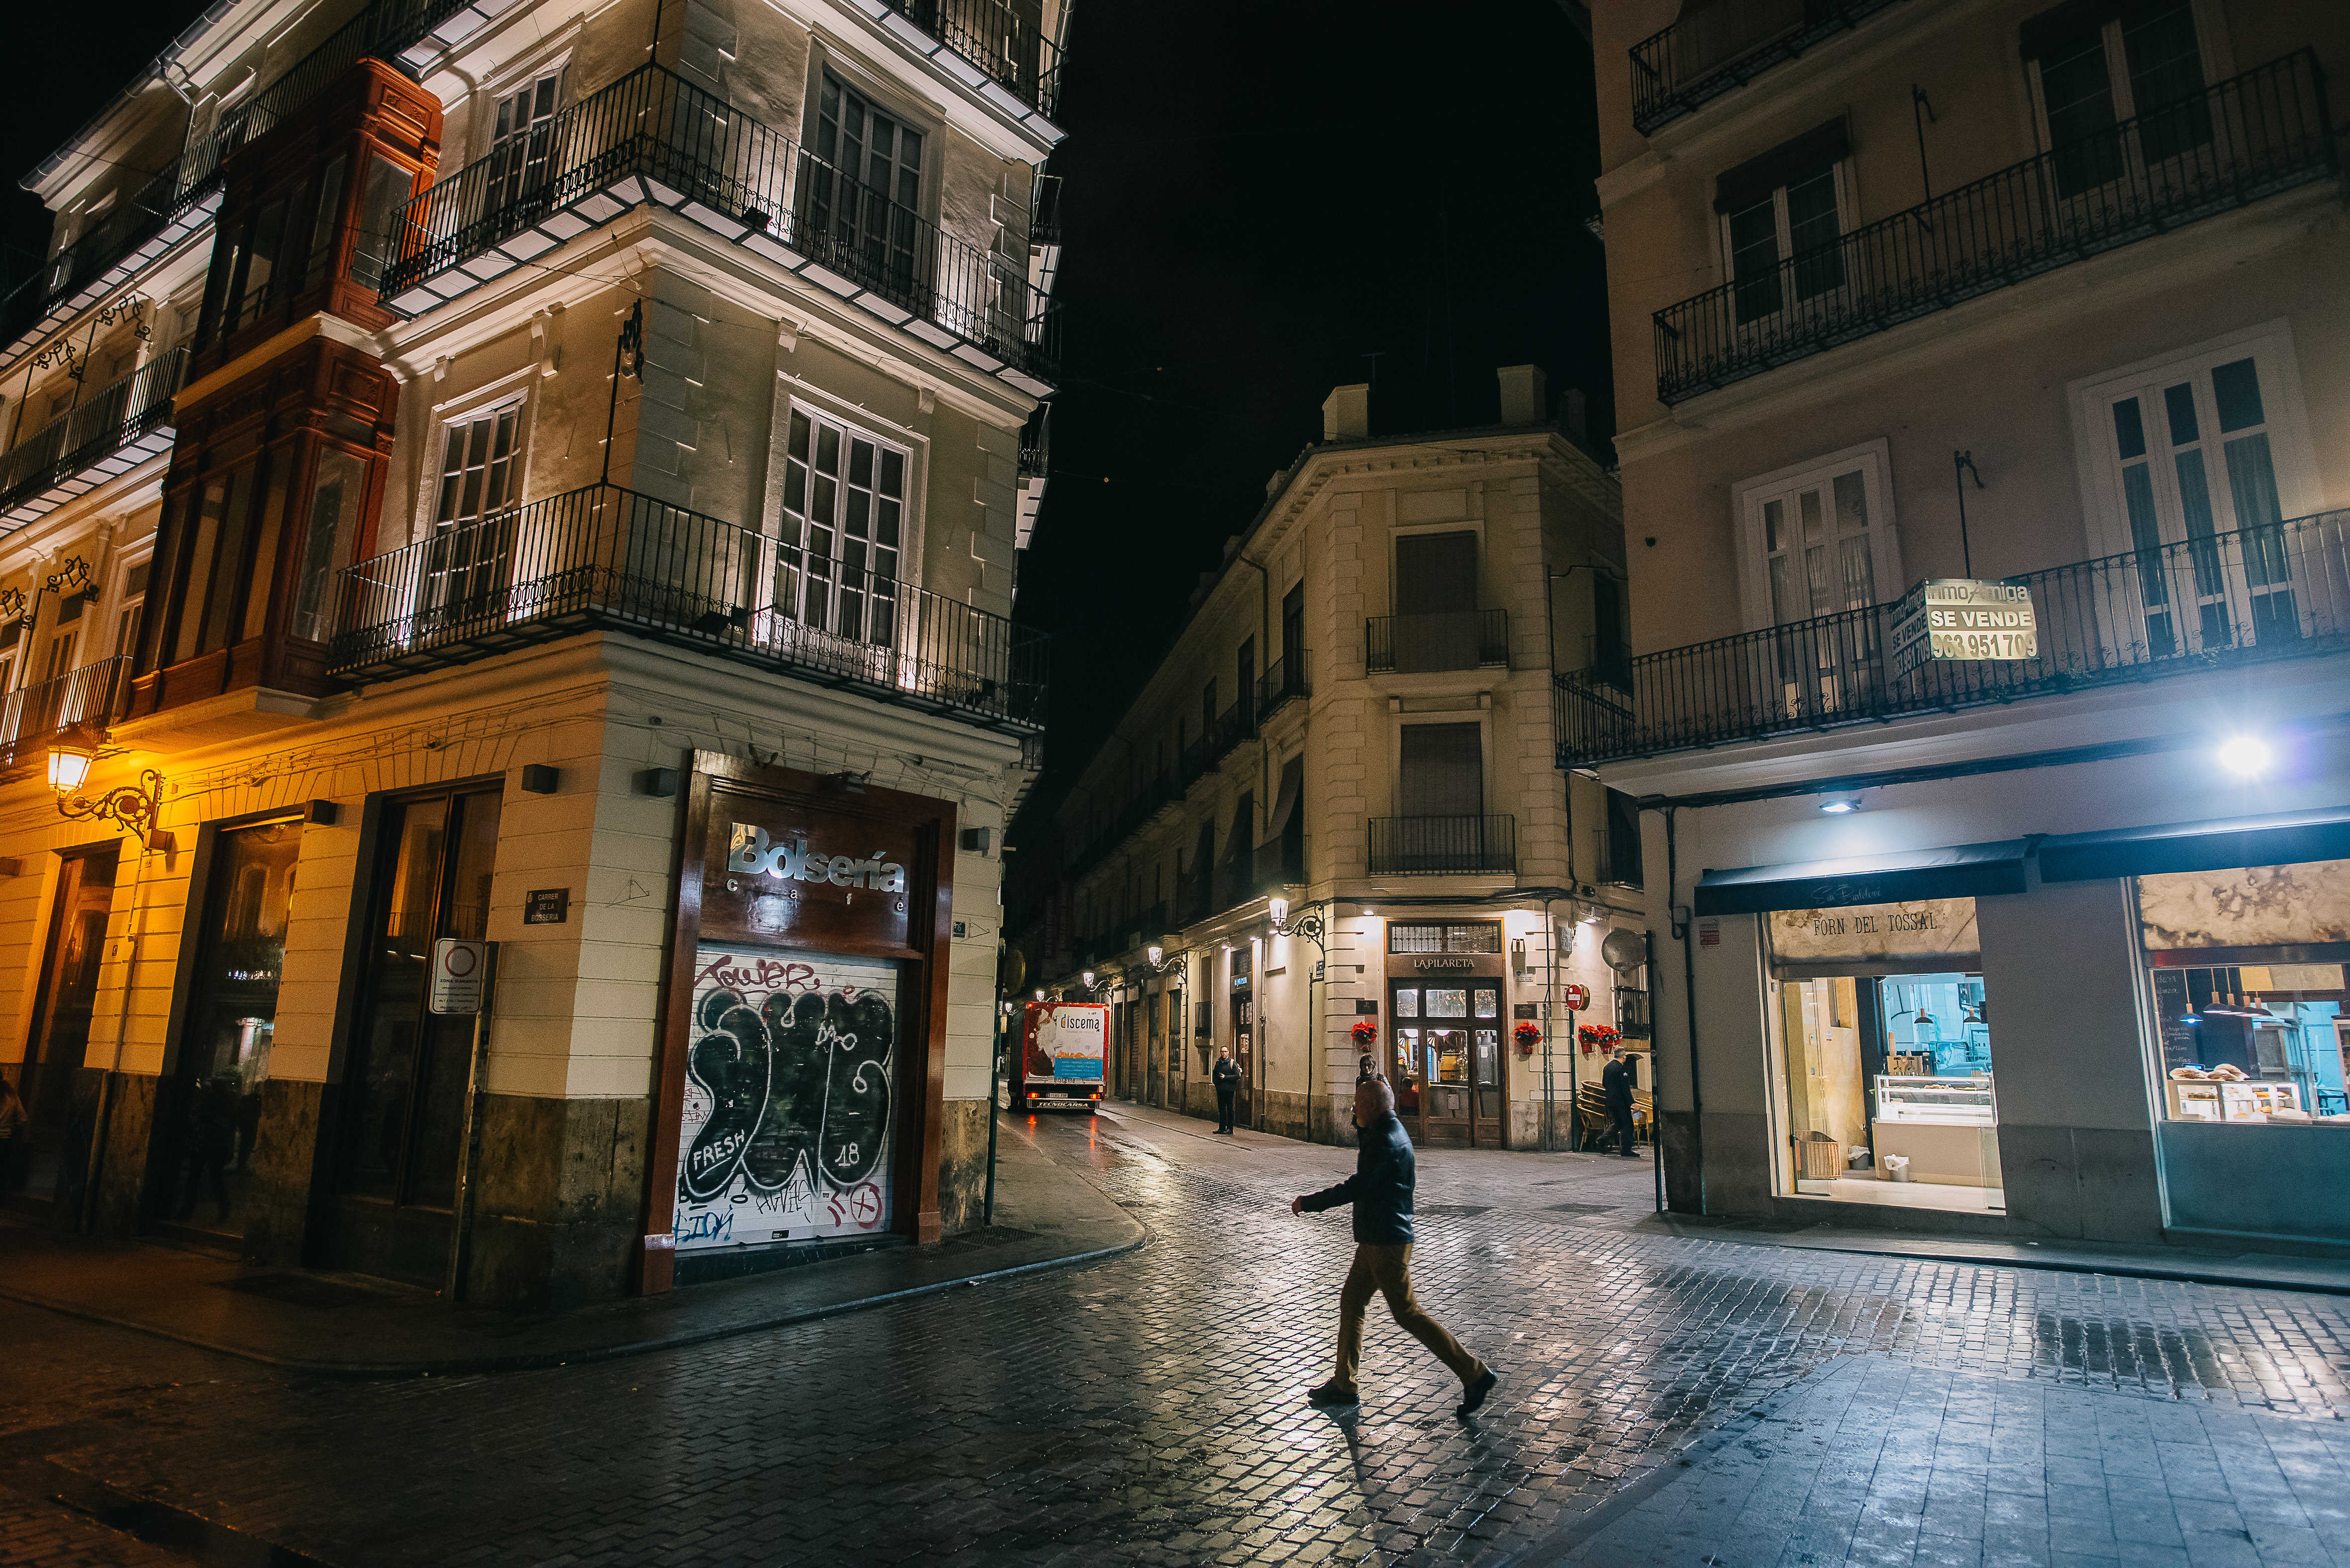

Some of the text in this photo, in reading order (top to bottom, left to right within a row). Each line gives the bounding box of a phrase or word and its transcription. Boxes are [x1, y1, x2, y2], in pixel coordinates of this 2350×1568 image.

[1893, 613, 1928, 649] SE VENDE
[1931, 610, 2033, 627] SE VENDE
[1916, 637, 1930, 664] 709
[1932, 633, 2037, 658] 963 951 709
[728, 822, 904, 893] Bolsería
[1814, 912, 1937, 936] FORN DEL TOSSAL
[1061, 1014, 1099, 1029] discema
[693, 1129, 745, 1170] FRESH
[835, 1142, 860, 1167] 18
